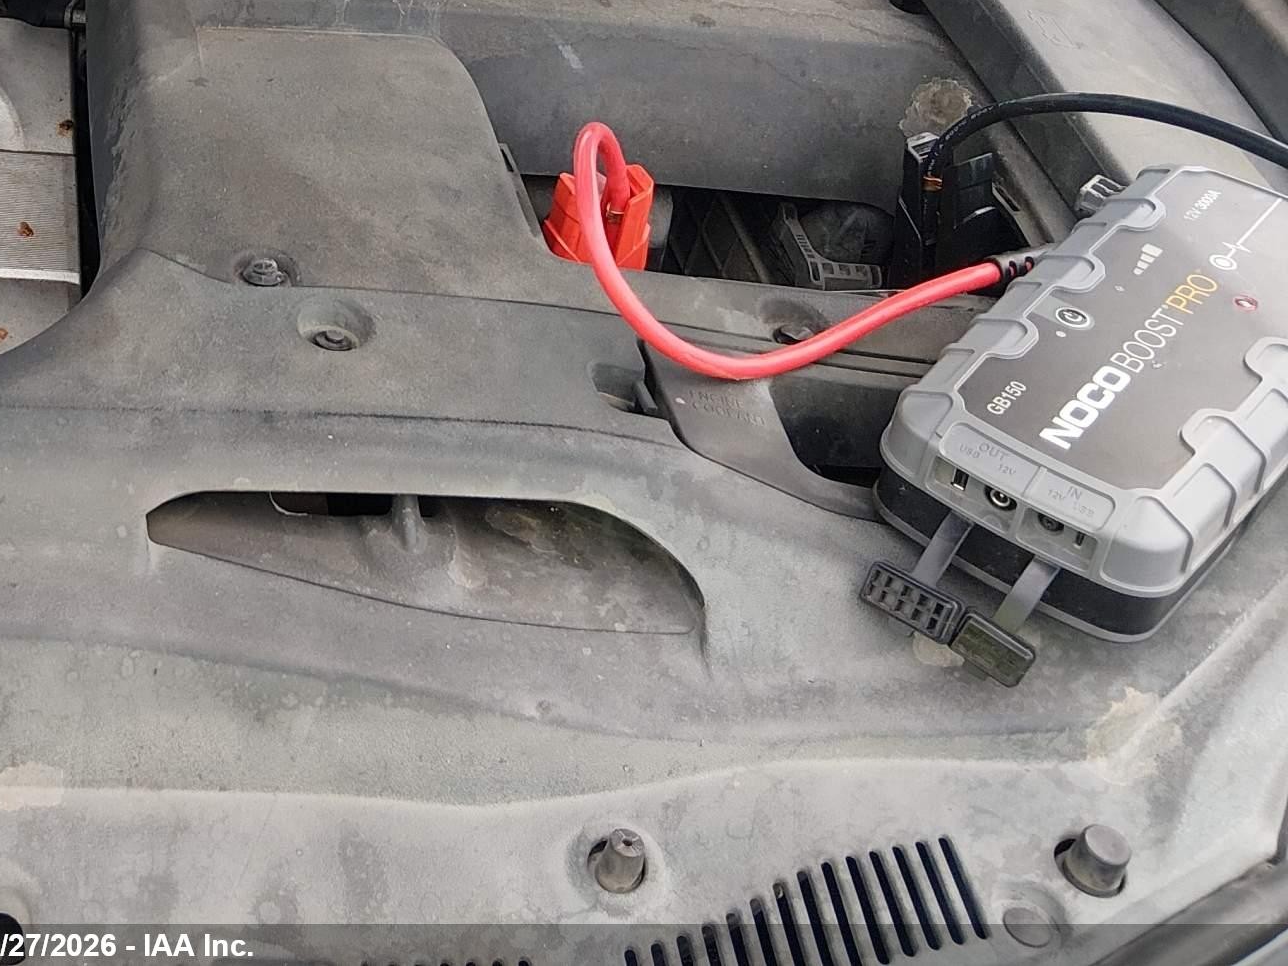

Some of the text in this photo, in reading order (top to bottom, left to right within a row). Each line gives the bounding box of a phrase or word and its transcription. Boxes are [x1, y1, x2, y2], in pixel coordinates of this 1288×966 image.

[1166, 272, 1221, 316] PRO
[986, 380, 1027, 416] GB150
[977, 442, 1011, 461] OUT
[998, 463, 1017, 476] 12V
[1047, 489, 1067, 501] 12V
[1067, 485, 1083, 500] IN
